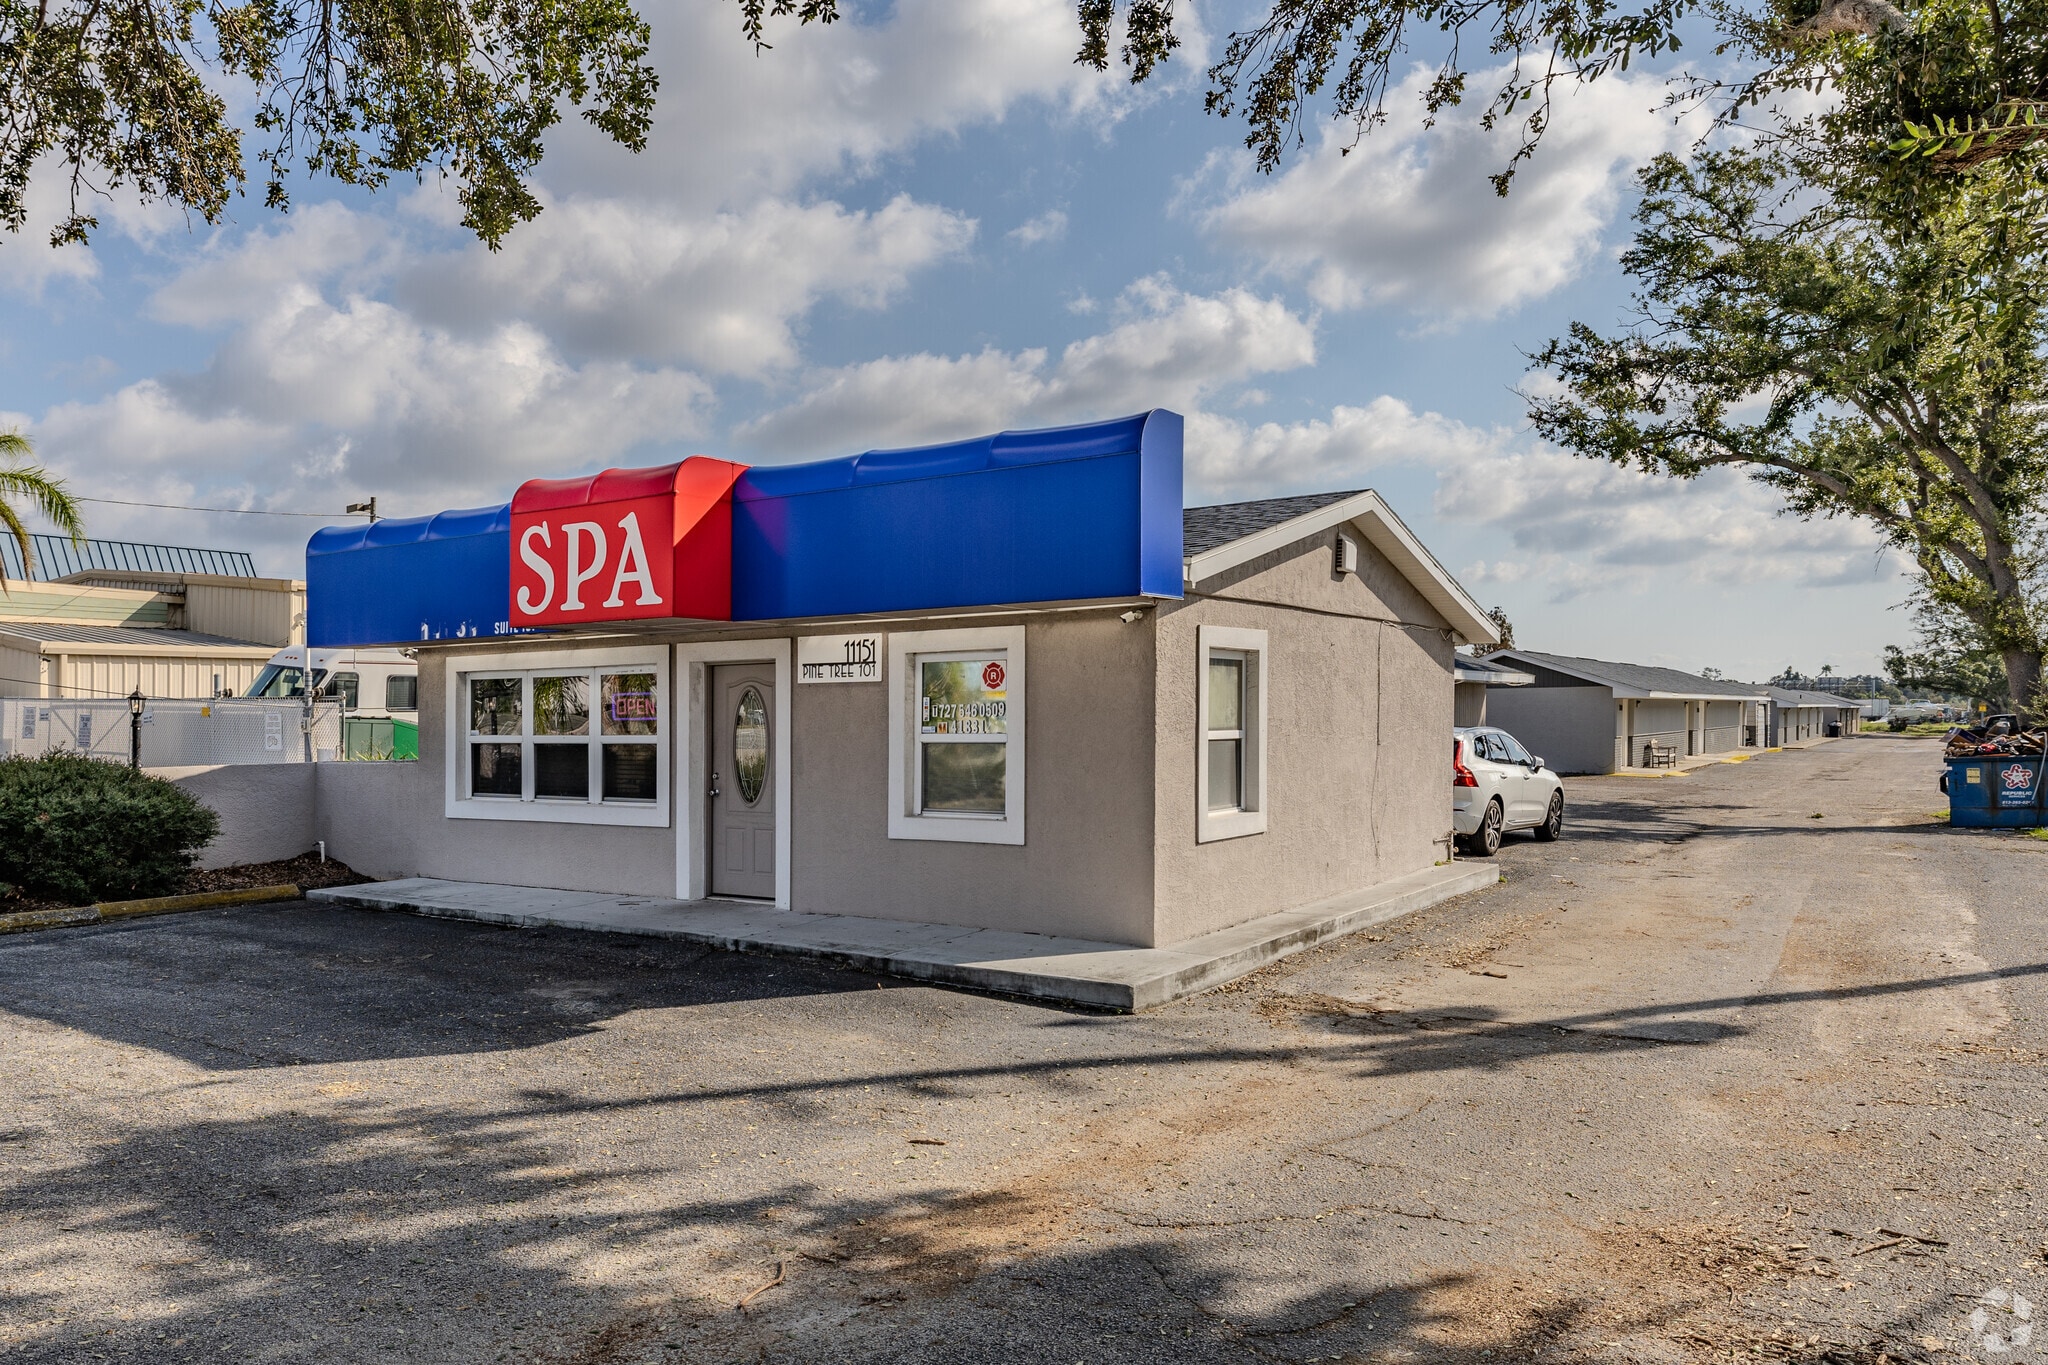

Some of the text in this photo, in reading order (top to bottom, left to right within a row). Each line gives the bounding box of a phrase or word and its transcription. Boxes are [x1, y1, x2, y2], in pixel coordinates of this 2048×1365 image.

[516, 511, 663, 615] SPA
[844, 638, 876, 664] 11151
[802, 662, 876, 679] PINE TREE 101
[616, 698, 656, 715] OPEN
[938, 703, 957, 719] 727
